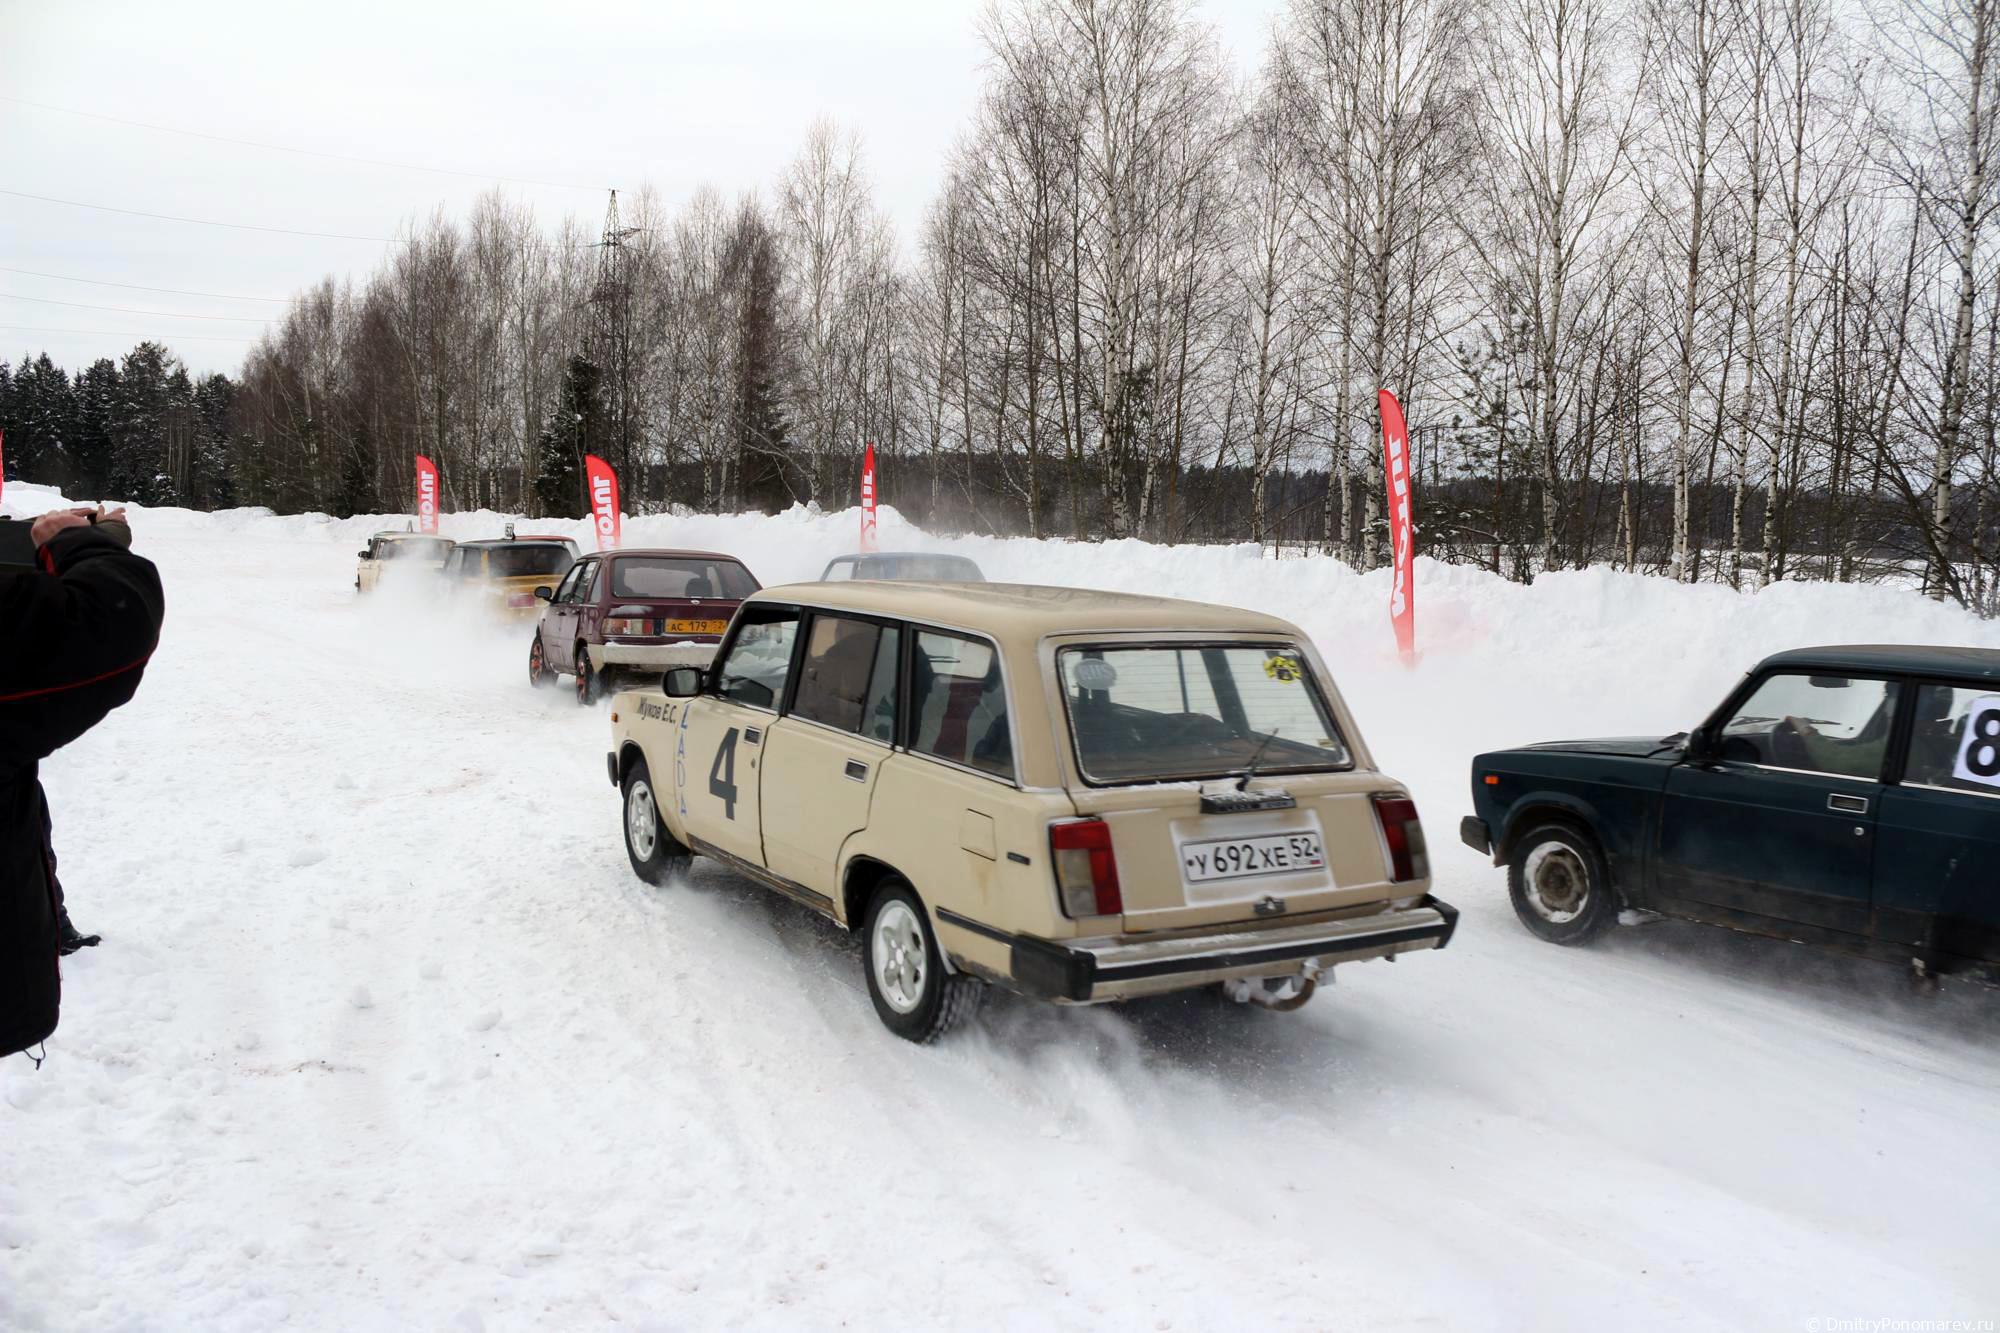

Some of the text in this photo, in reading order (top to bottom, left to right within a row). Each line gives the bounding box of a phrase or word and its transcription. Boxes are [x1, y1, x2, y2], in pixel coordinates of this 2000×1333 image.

[862, 469, 876, 548] OTUL
[689, 621, 707, 632] 179
[709, 727, 740, 821] 4
[1290, 838, 1313, 858] 52
